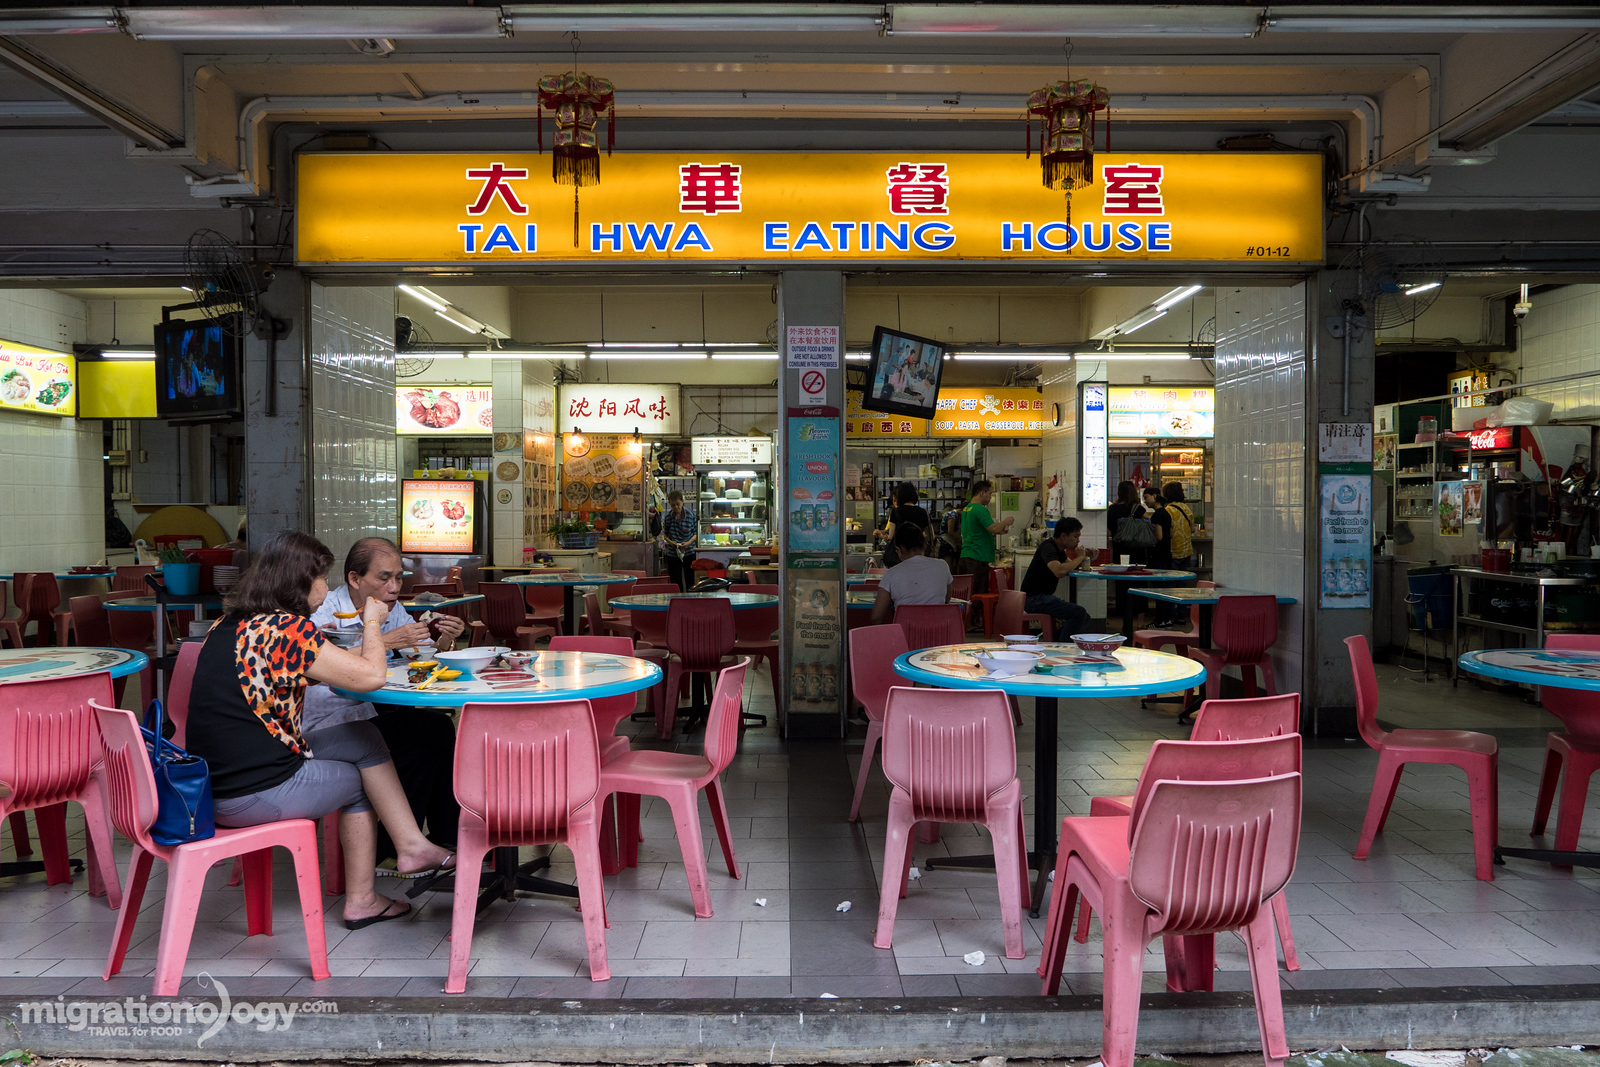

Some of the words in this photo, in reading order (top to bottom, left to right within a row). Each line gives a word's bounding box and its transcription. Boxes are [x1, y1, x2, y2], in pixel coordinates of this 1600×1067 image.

[457, 222, 538, 253] TAI
[590, 222, 714, 253] HWA
[763, 221, 956, 253] EATING
[1001, 221, 1172, 253] HOUSE
[1246, 246, 1291, 258] #01-12
[789, 327, 837, 336] 外来饮食不准
[789, 336, 837, 345] 在本餐室饮用
[569, 395, 671, 421] 沈阳风味
[936, 398, 957, 410] HAPPY
[960, 398, 978, 410] CHEF
[808, 426, 830, 435] Heaven
[1325, 424, 1366, 437] 请注意
[1324, 517, 1340, 525] Feel
[1341, 517, 1359, 525] fresh
[1360, 517, 1369, 526] to
[1329, 526, 1342, 534] the
[1342, 526, 1364, 534] max?
[813, 622, 831, 631] fresh
[832, 623, 840, 631] to
[800, 630, 813, 638] the
